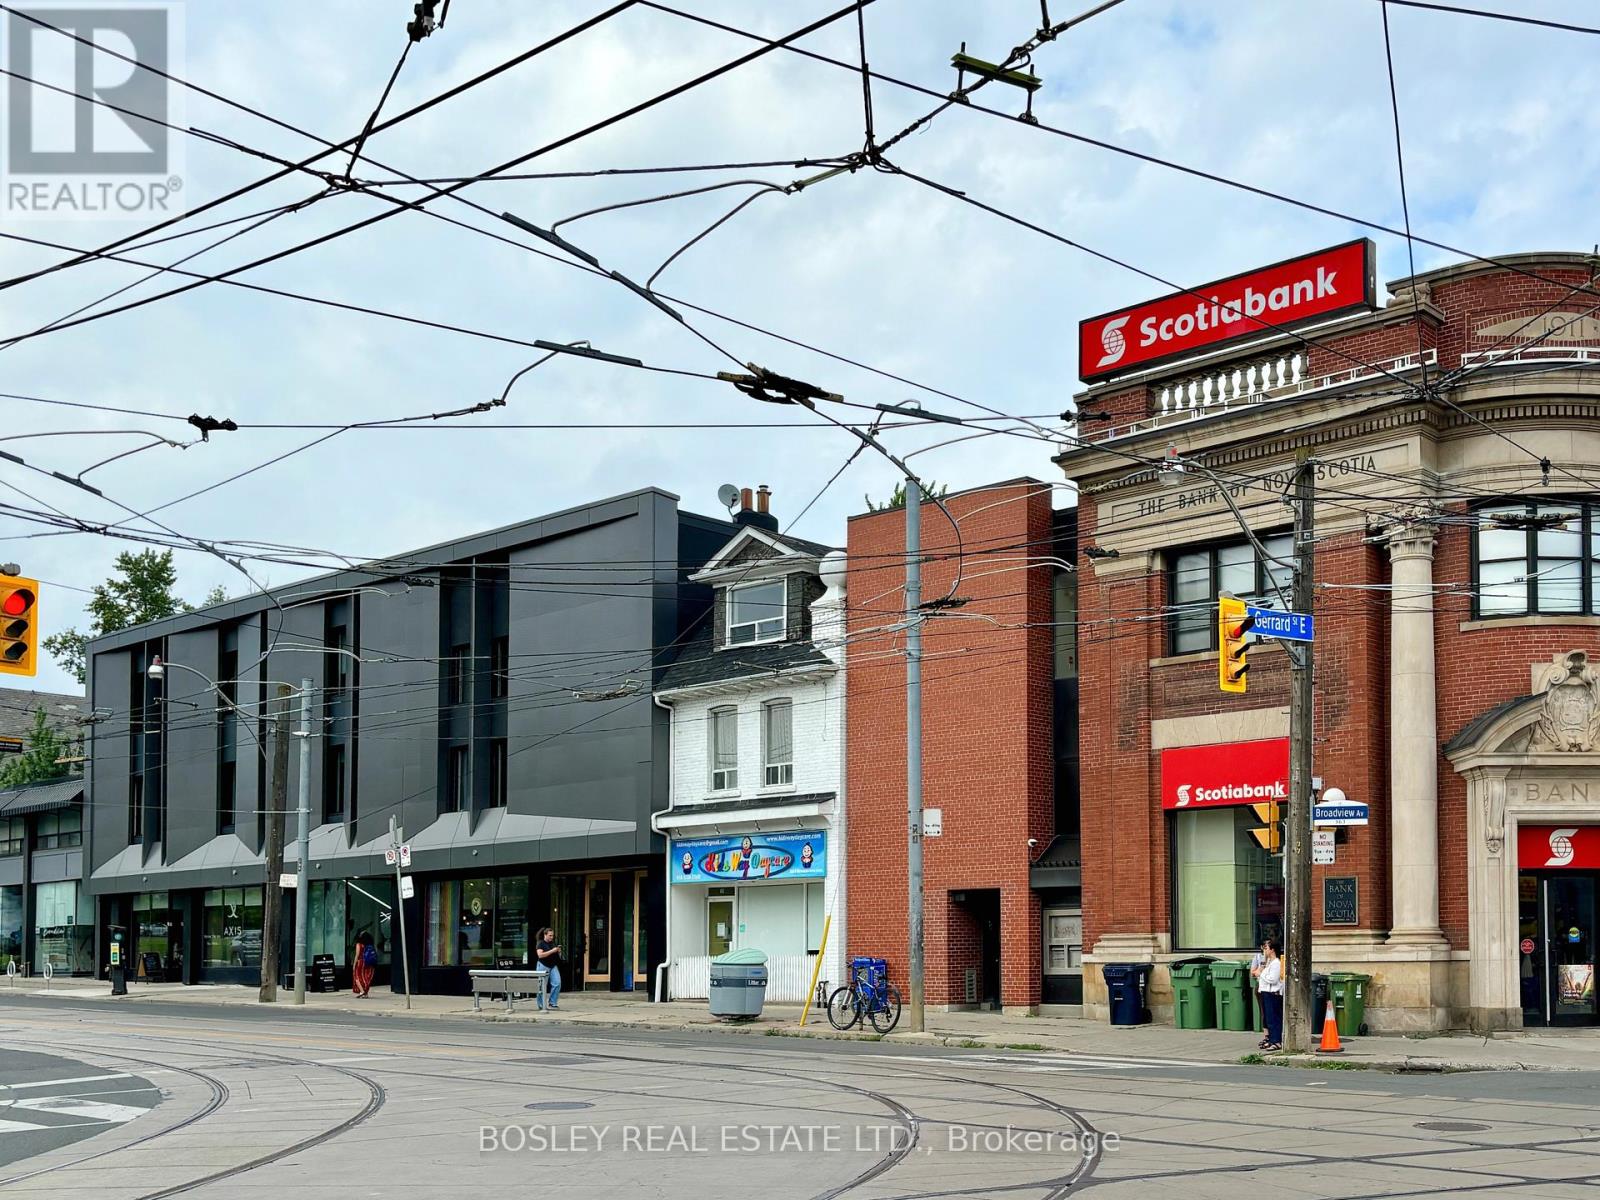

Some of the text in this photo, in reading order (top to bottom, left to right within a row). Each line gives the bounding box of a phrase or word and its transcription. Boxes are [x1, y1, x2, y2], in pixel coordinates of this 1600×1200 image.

[1140, 266, 1338, 347] Scotiabank
[1138, 497, 1166, 516] THE
[1179, 487, 1218, 510] BANK
[1263, 471, 1297, 492] NOV
[1317, 456, 1376, 481] SCOTIA
[1255, 611, 1306, 634] Gerrard St E
[1195, 781, 1285, 801] Scotiabank
[1315, 808, 1355, 818] Broadview
[1329, 885, 1353, 893] BANK
[1329, 900, 1353, 908] NOVA
[1327, 909, 1355, 918] SCOTIA
[224, 926, 242, 936] AXIS
